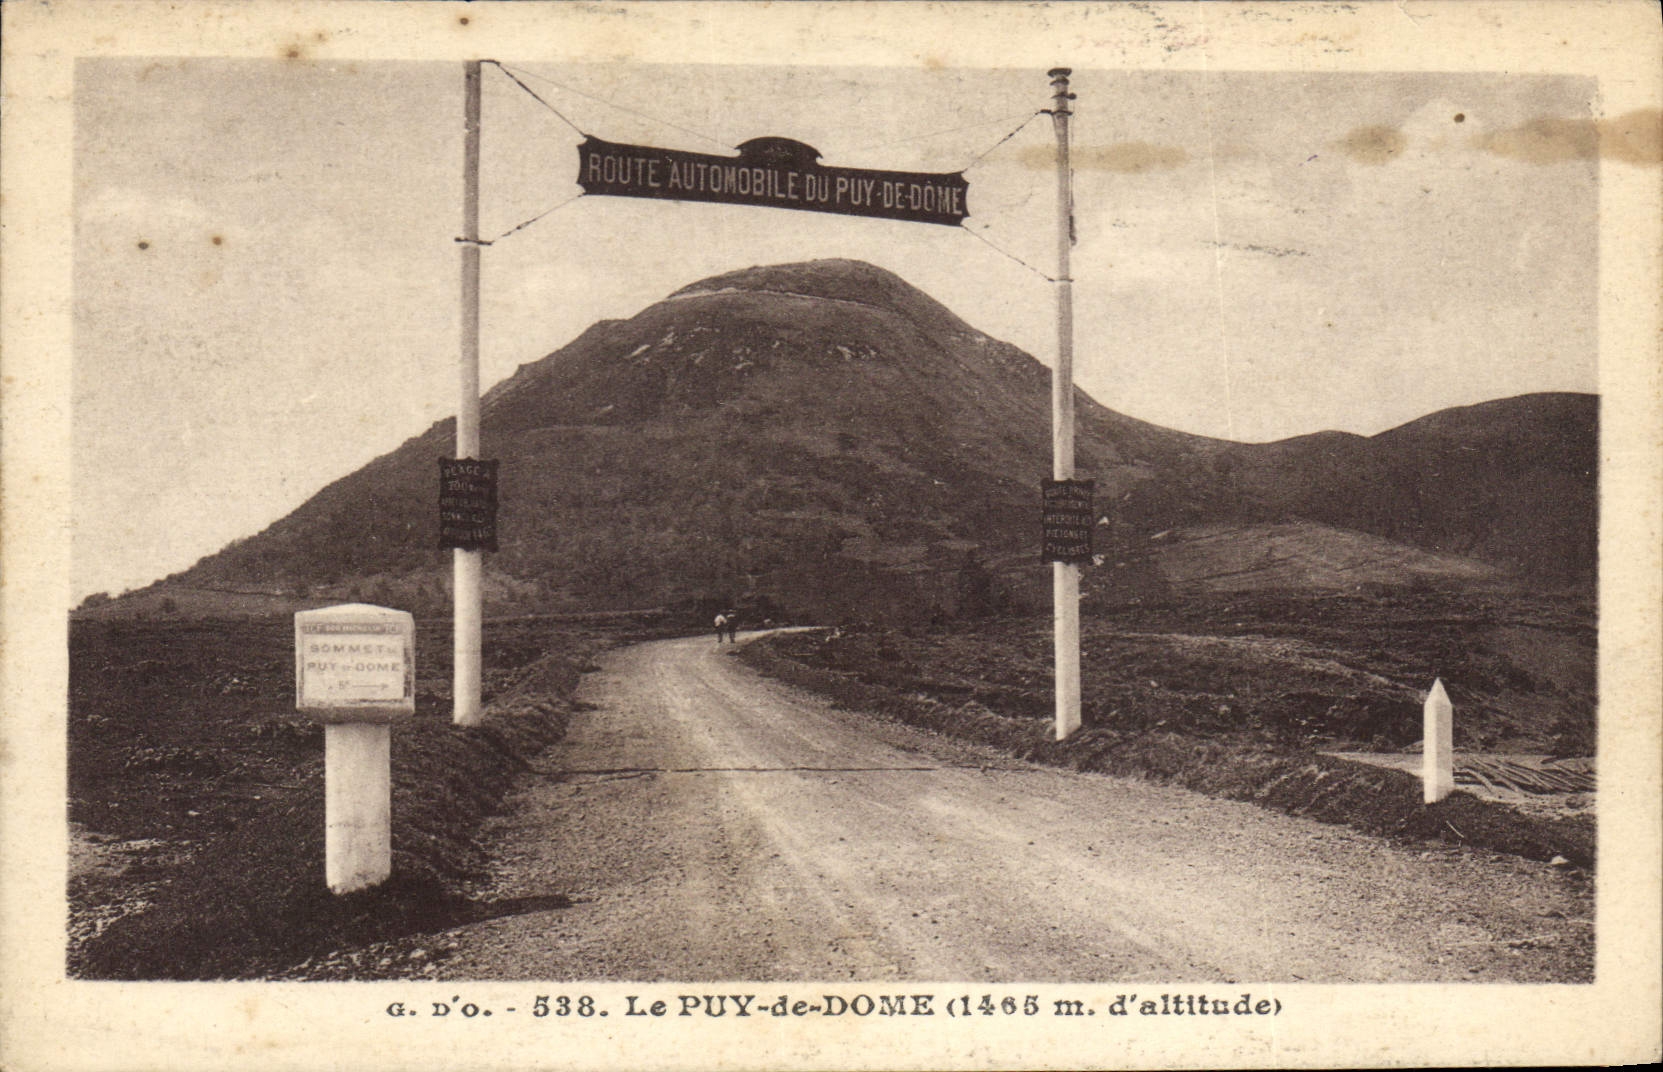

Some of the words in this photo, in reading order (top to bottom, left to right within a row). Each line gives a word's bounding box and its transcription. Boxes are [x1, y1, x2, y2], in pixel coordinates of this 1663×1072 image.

[588, 153, 662, 188] ROUTE
[668, 161, 798, 200] AUTOMOBILE
[805, 173, 829, 203] DU
[310, 644, 384, 654] SOMMET
